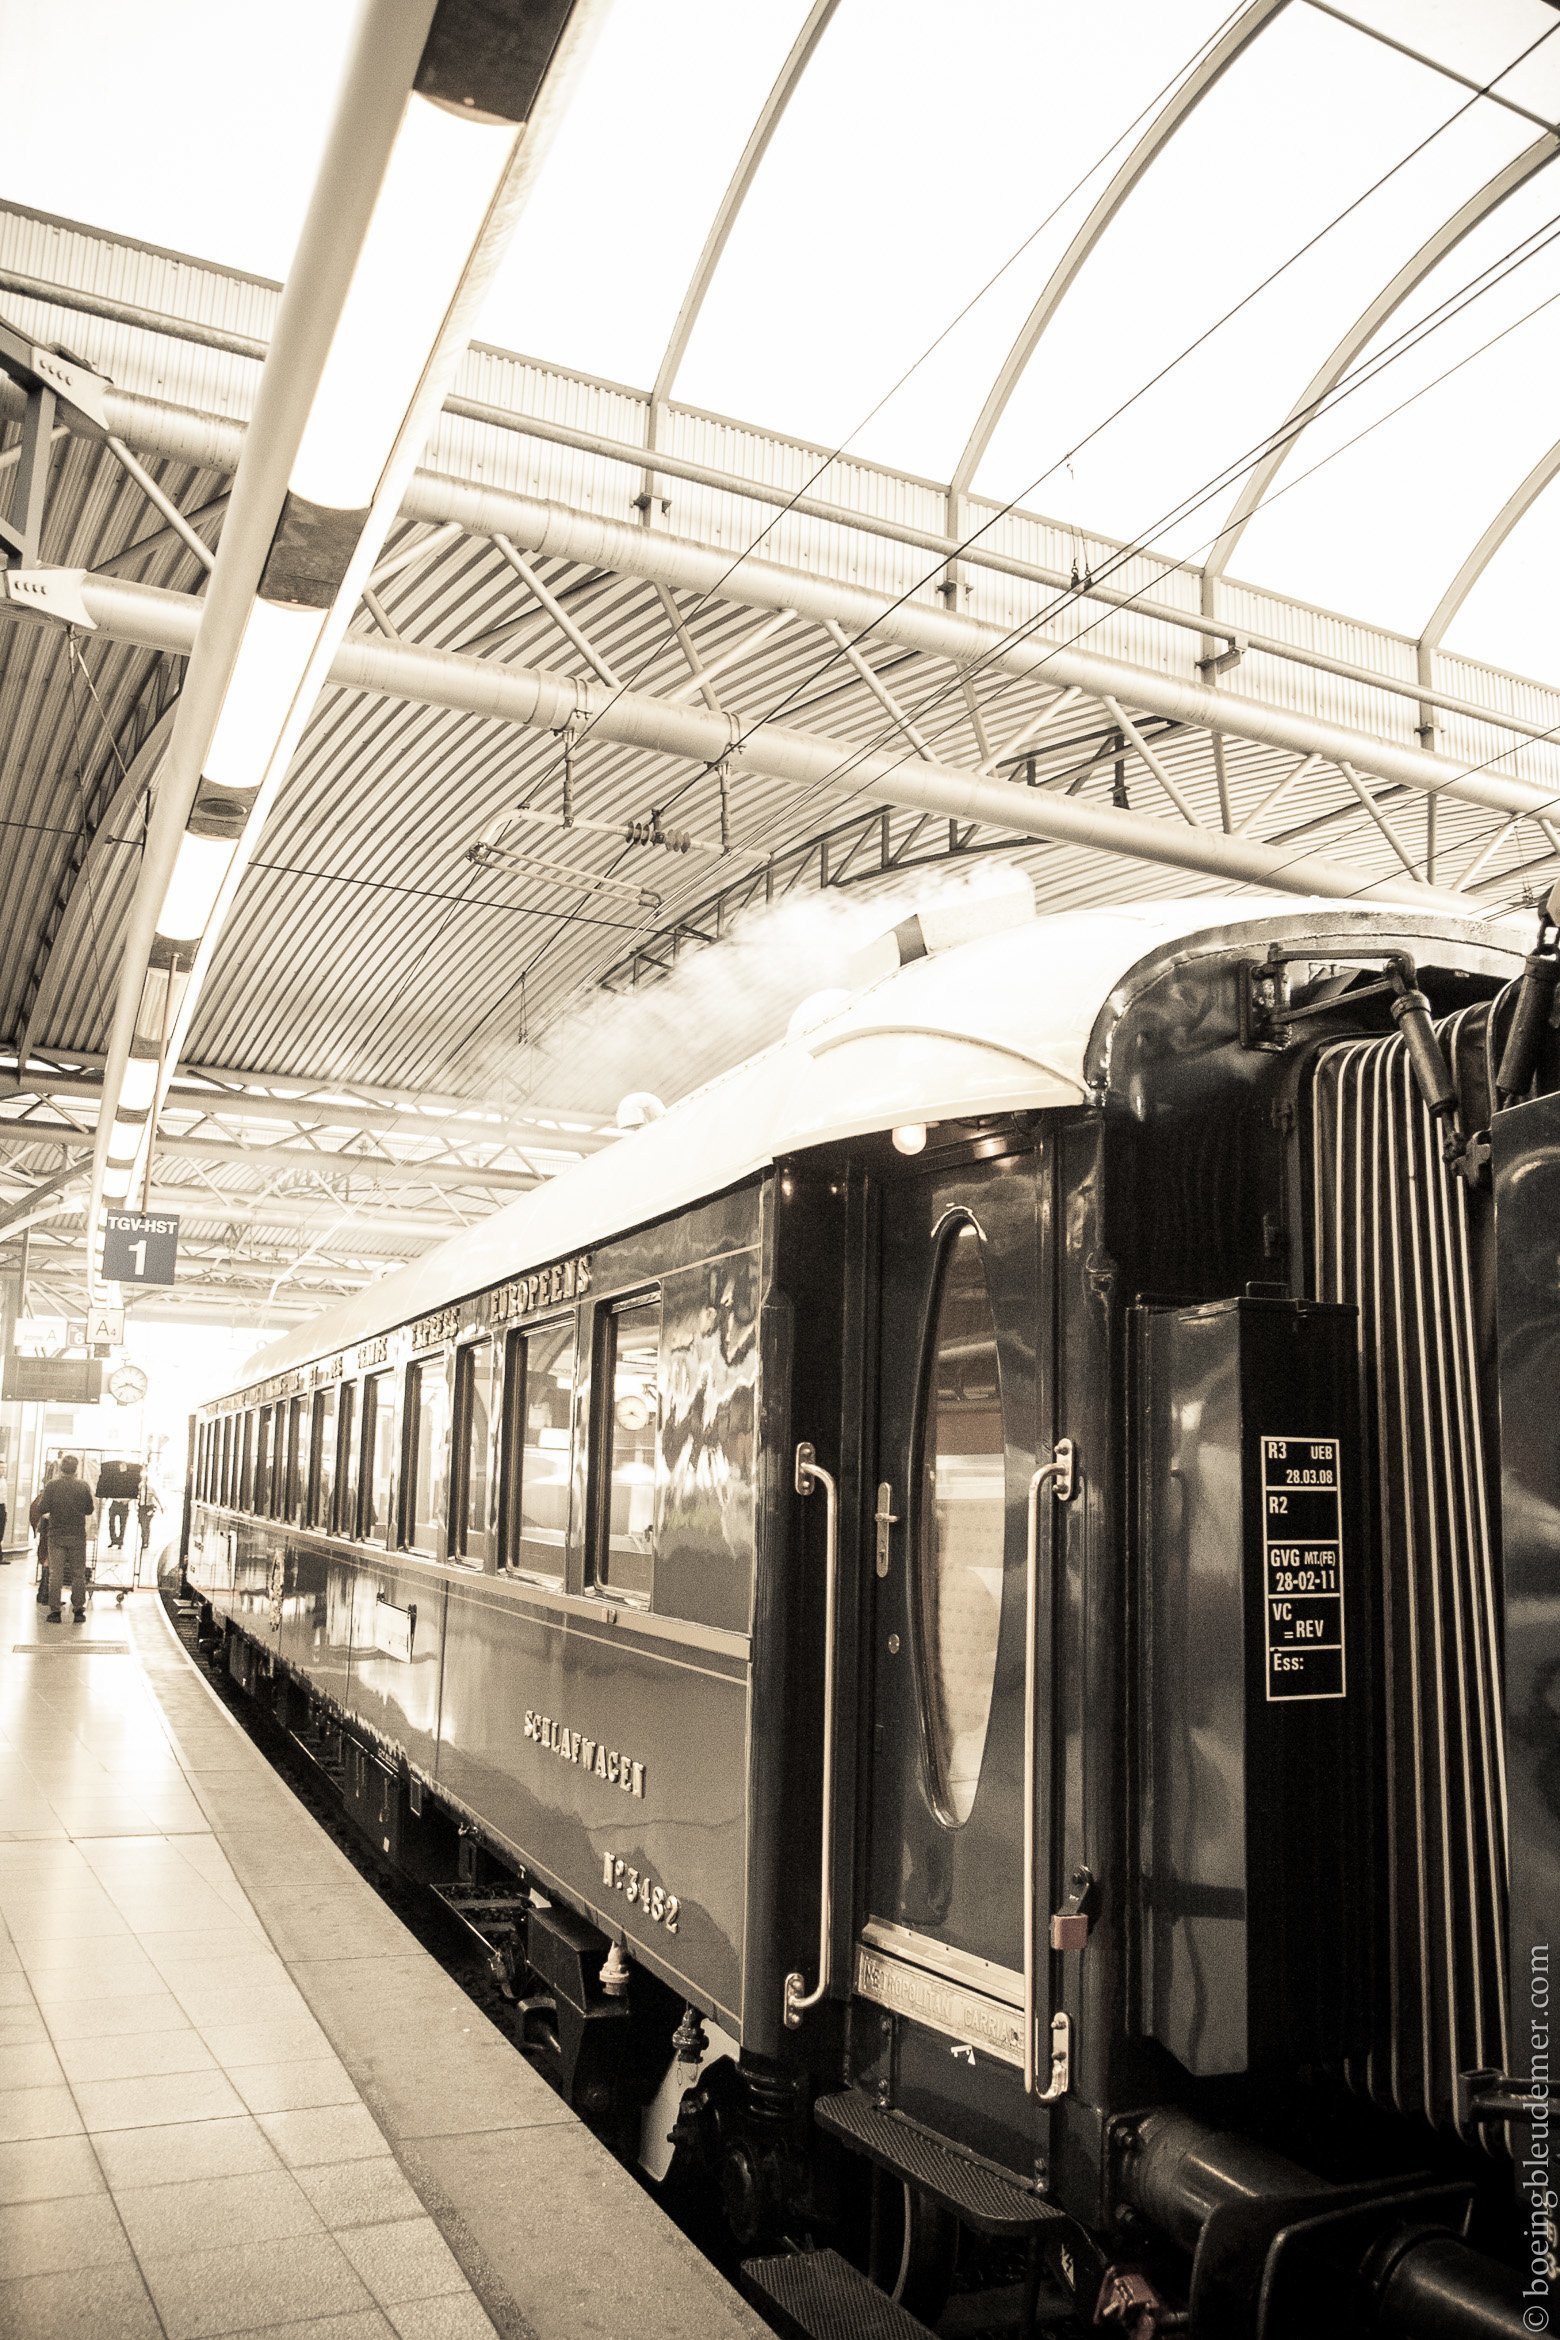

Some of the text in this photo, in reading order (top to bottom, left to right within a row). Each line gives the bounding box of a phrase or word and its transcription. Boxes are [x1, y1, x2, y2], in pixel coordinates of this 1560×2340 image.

[108, 1216, 178, 1235] TGV-HST
[128, 1239, 147, 1276] 1
[489, 1254, 592, 1323] EUROPEENS
[74, 1332, 85, 1344] 6
[1268, 1442, 1333, 1460] R3 UEB
[1286, 1469, 1333, 1485] 28.03.08
[1269, 1496, 1288, 1514] R2
[1270, 1549, 1300, 1567] GVG
[1275, 1570, 1336, 1592] 28-02-11
[1272, 1603, 1293, 1621] VC
